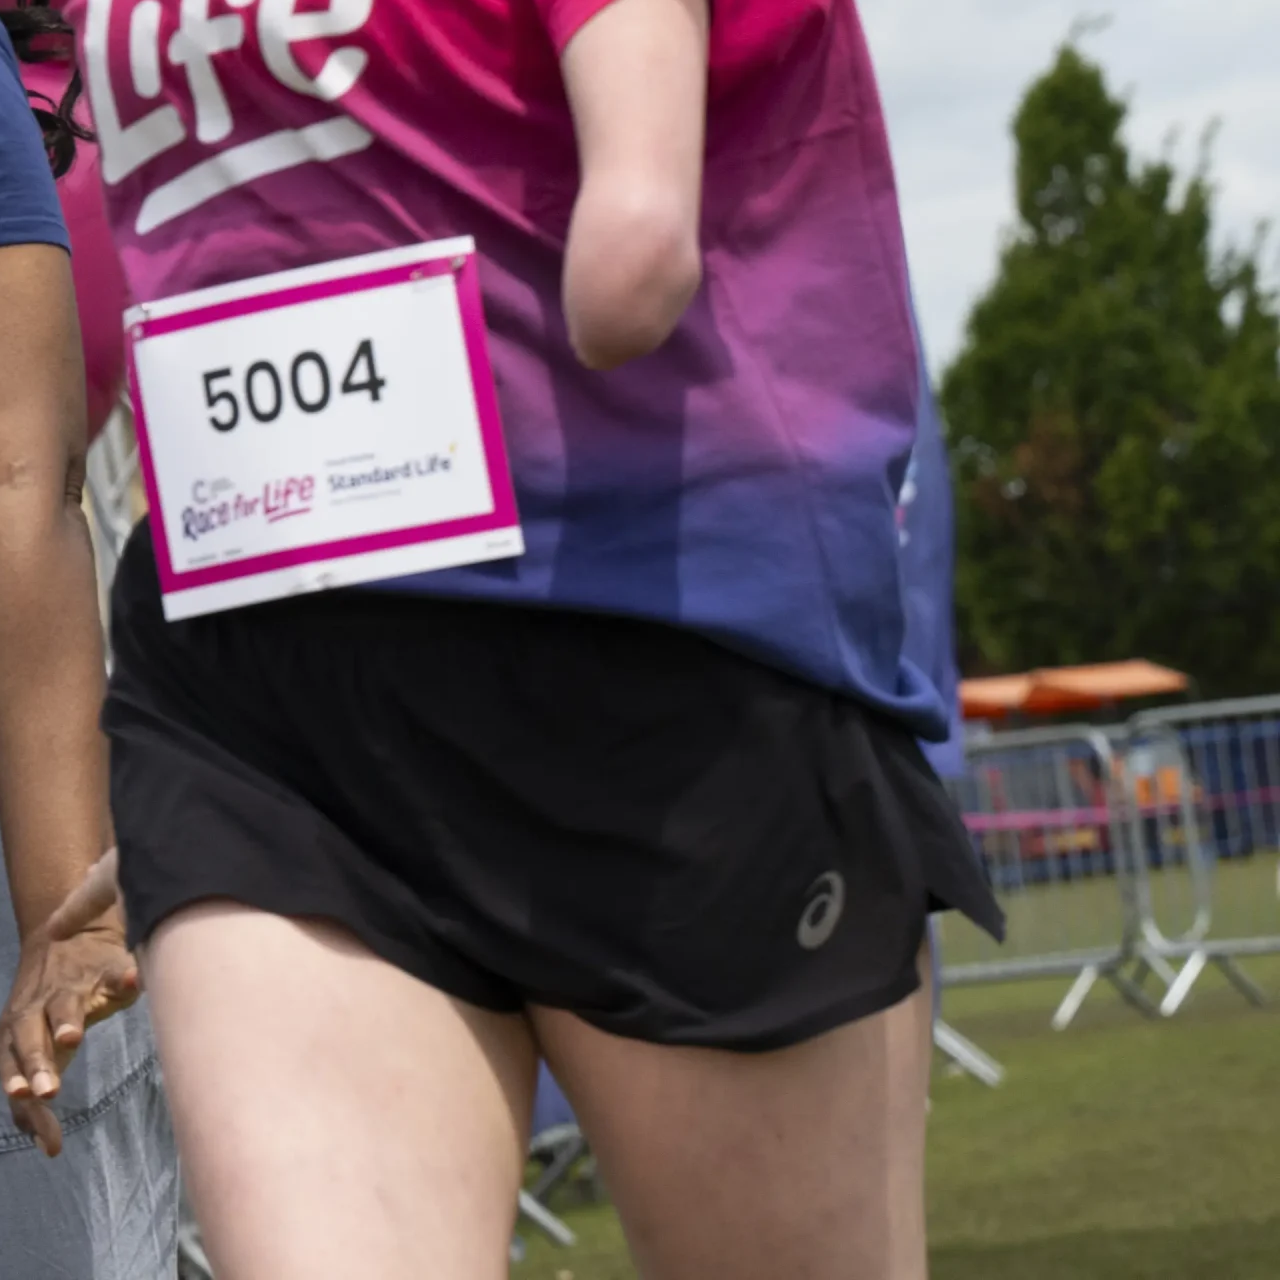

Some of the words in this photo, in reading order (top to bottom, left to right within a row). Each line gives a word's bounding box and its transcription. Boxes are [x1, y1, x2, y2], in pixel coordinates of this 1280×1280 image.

[202, 337, 387, 433] 5004
[181, 502, 231, 541] Race
[262, 475, 316, 516] Life
[327, 461, 412, 492] Standard
